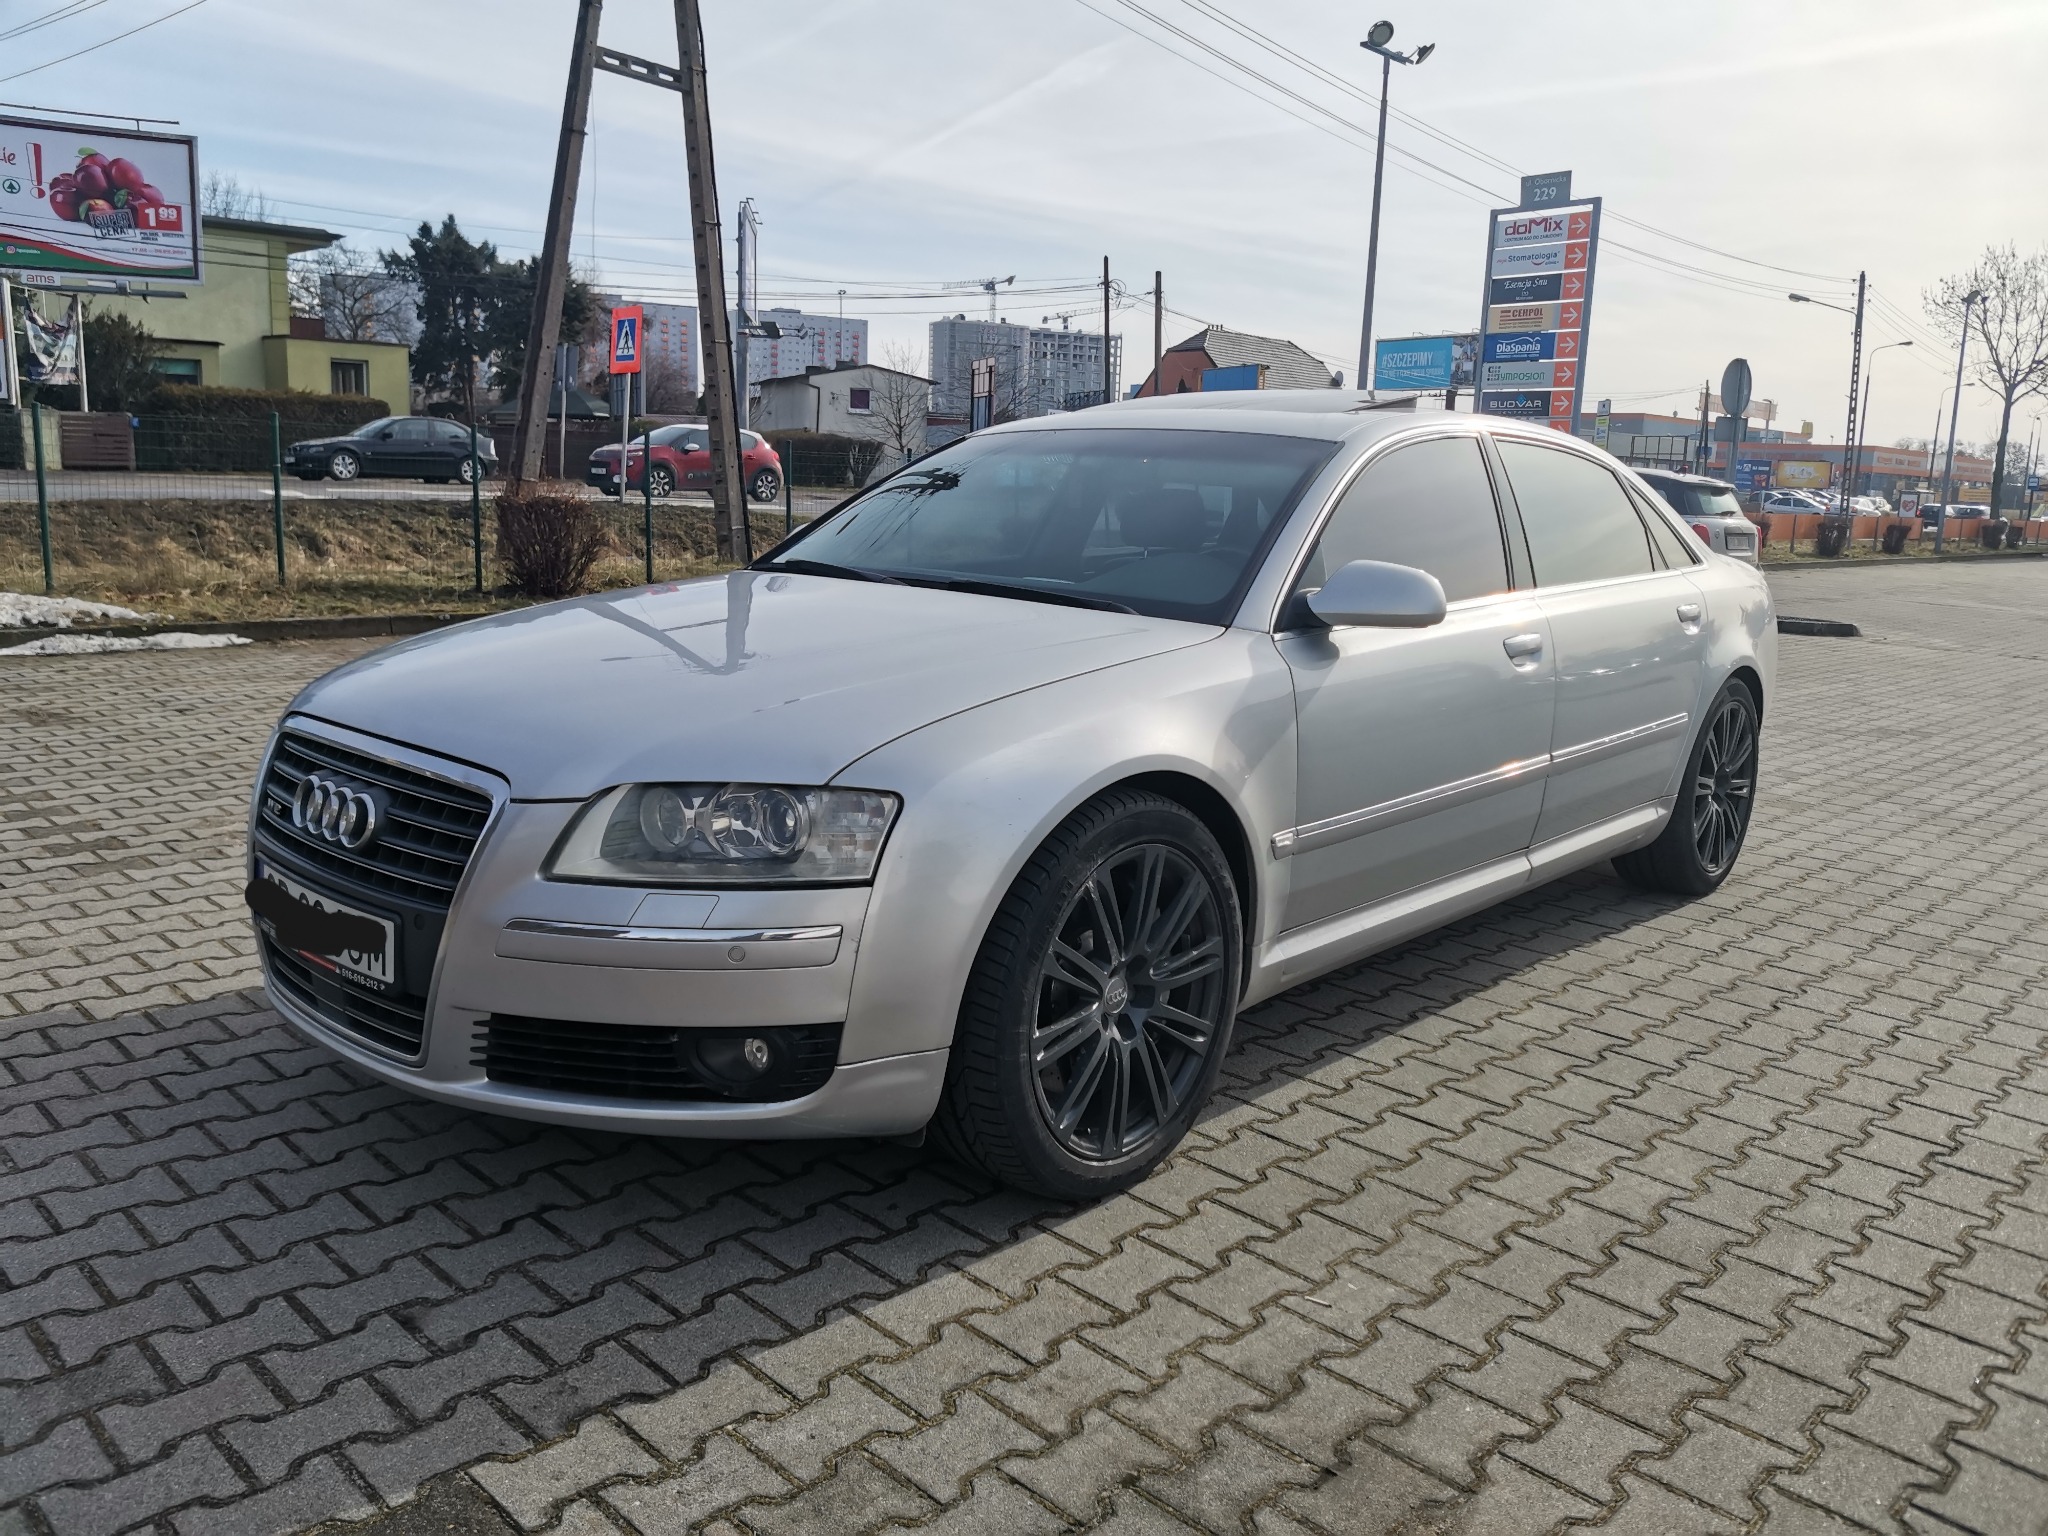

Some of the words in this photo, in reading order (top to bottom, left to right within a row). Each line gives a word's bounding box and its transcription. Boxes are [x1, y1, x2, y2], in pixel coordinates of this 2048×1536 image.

[1533, 187, 1557, 201] 229
[95, 212, 130, 226] SUPER
[99, 225, 130, 238] CENA!
[1508, 253, 1558, 262] Stomatologia
[26, 273, 55, 284] ams
[1504, 279, 1532, 292] Esencja
[1382, 352, 1433, 368] #SZCZEPIMY
[1490, 400, 1542, 408] BUDVAR
